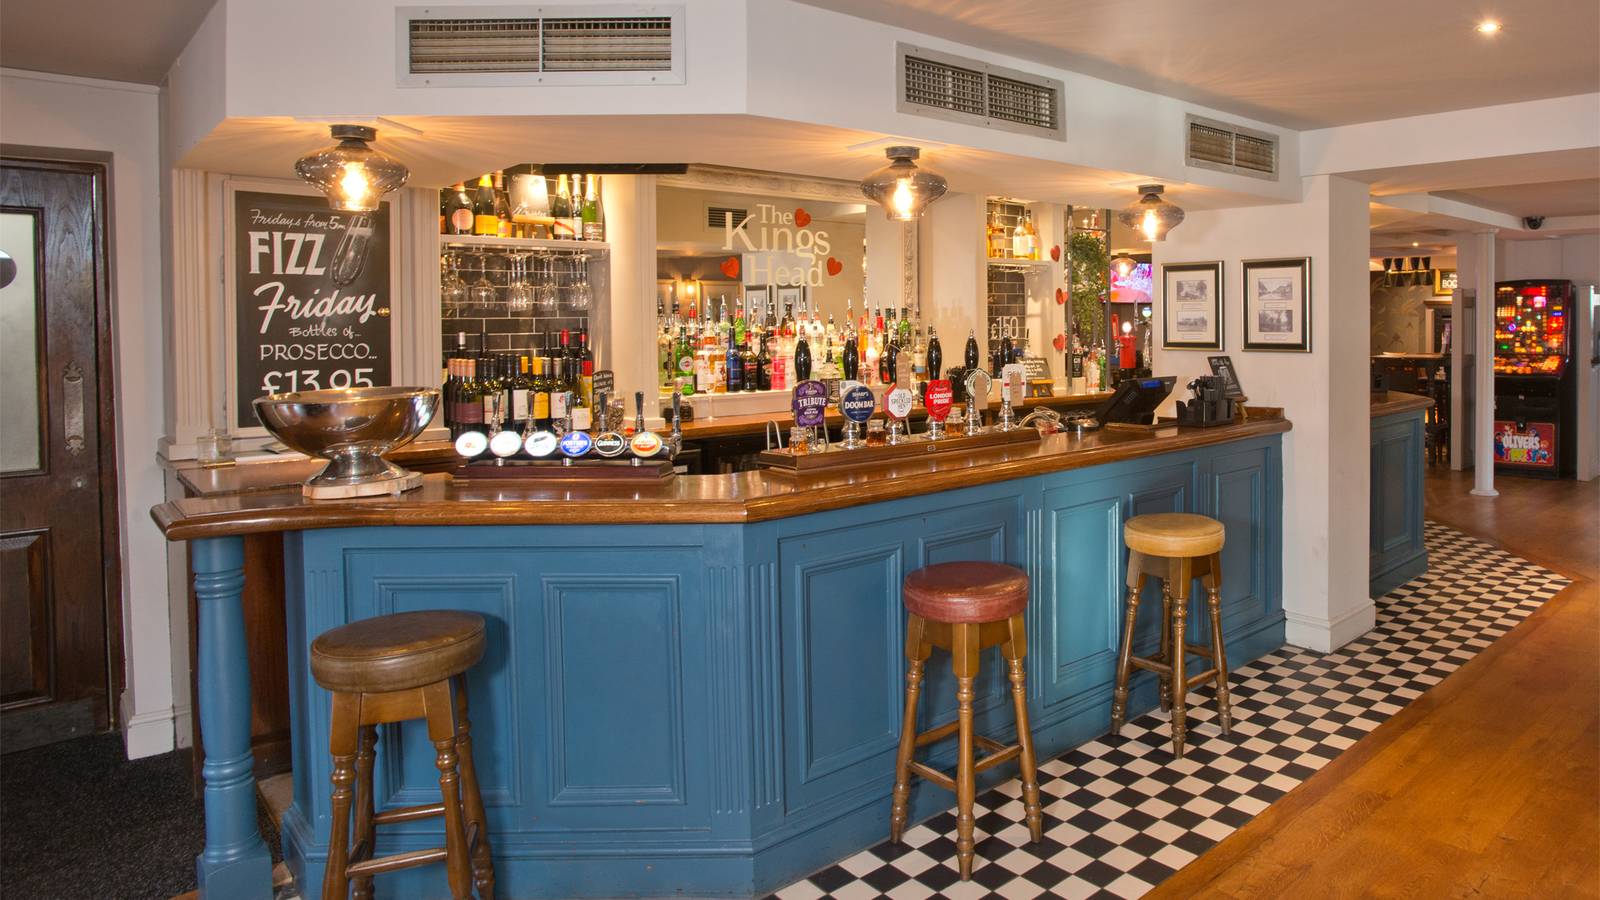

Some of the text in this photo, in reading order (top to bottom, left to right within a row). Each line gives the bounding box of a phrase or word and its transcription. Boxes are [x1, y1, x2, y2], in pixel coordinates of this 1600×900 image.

[249, 208, 301, 228] Fridays
[304, 213, 328, 230] from
[757, 203, 793, 225] The
[721, 211, 831, 265] Kings
[248, 231, 326, 275] FIZZ
[747, 255, 825, 287] Head
[253, 281, 377, 334] Friday
[288, 320, 338, 337] Bottles
[798, 397, 826, 407] TRIBUTE
[845, 400, 874, 409] DOOM BAR
[930, 391, 953, 399] LONDON
[1503, 432, 1541, 450] OLIVERS
